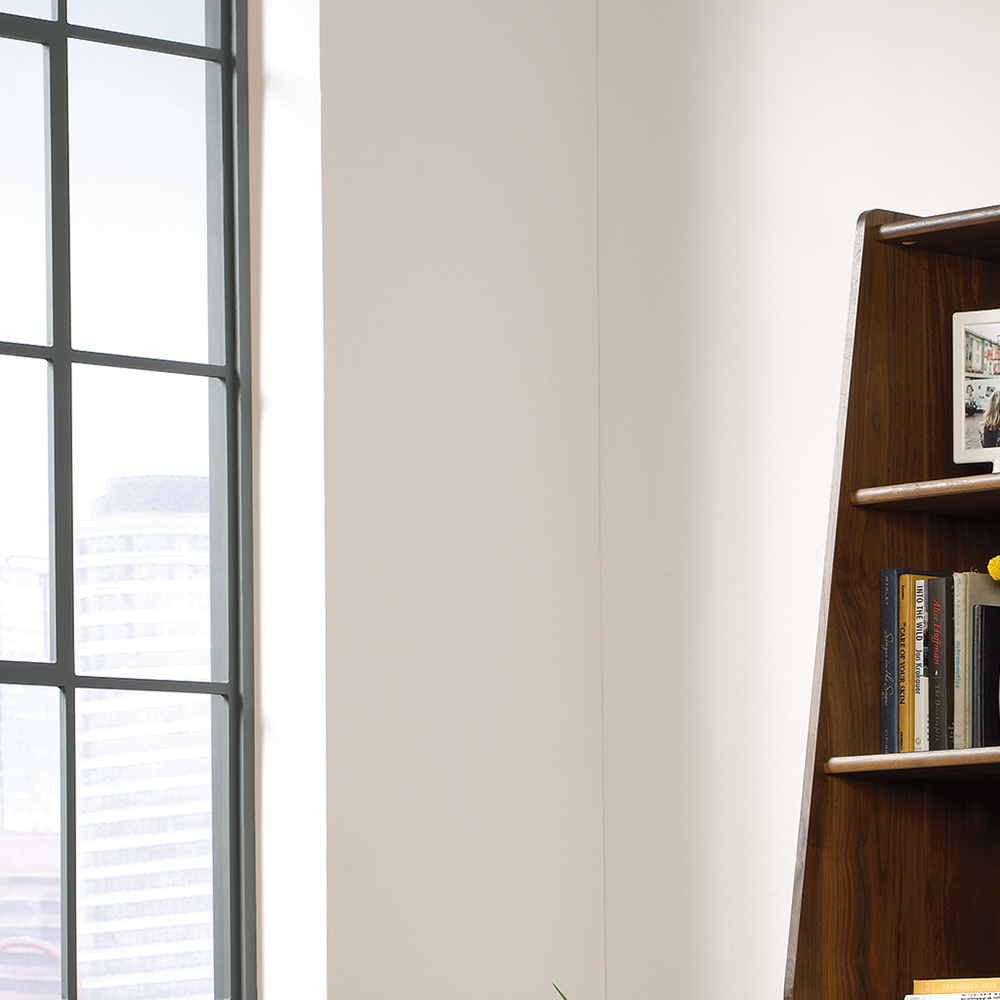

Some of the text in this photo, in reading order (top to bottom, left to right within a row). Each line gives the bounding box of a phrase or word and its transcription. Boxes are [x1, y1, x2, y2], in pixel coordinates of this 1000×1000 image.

[916, 585, 924, 604] INTO
[915, 606, 924, 619] THE
[933, 598, 941, 621] Alice
[915, 622, 924, 641] WILD
[931, 623, 942, 665] Hoffman
[899, 649, 906, 659] OF
